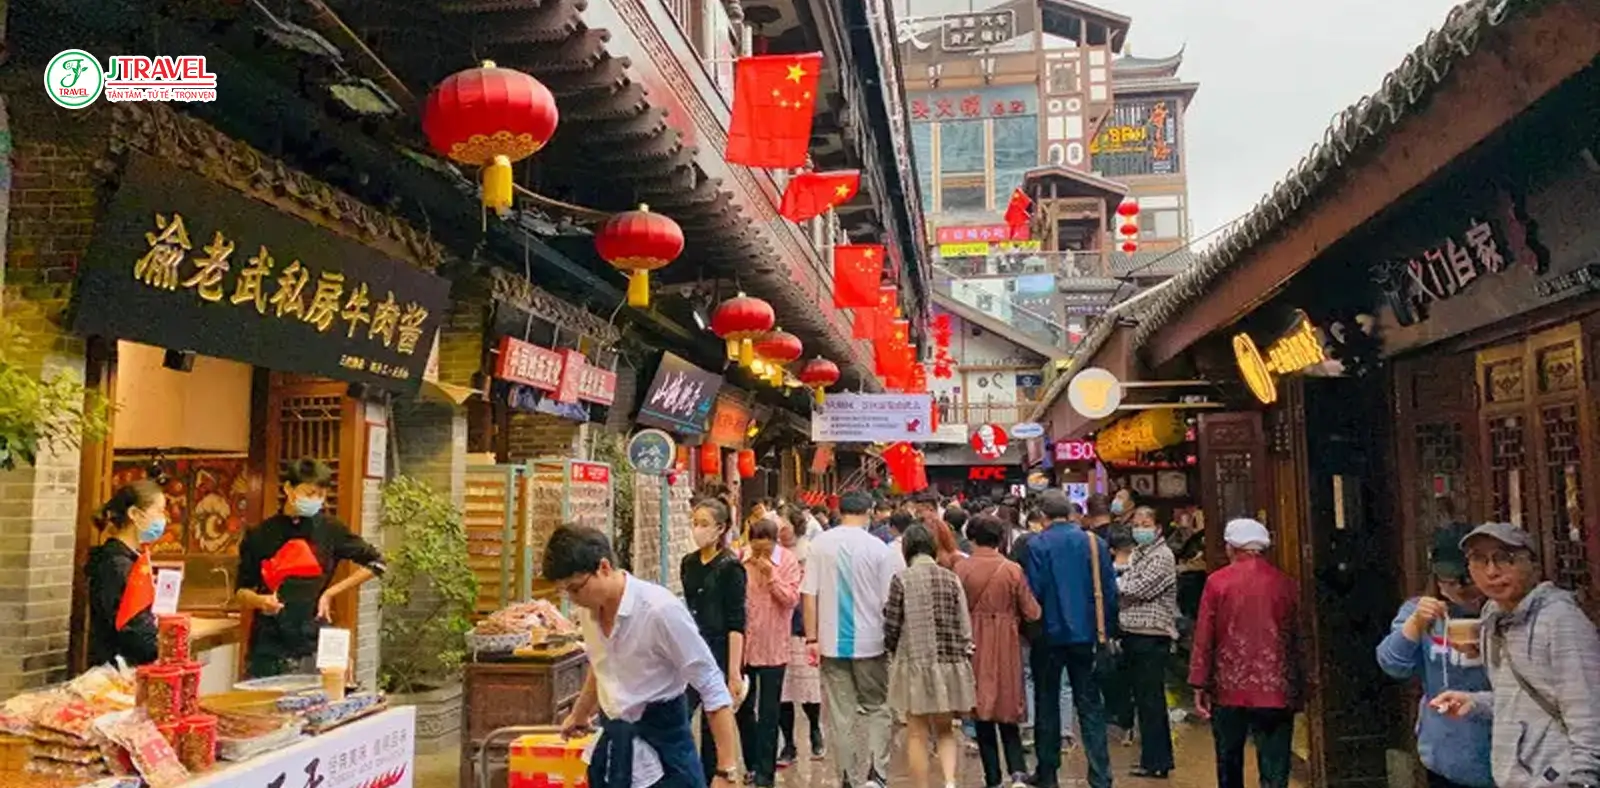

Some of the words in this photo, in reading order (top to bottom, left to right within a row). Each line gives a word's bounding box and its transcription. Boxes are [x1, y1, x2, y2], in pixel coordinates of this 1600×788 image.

[133, 211, 430, 357] 渝老武私房牛肉酱
[968, 466, 1007, 480] KFC
